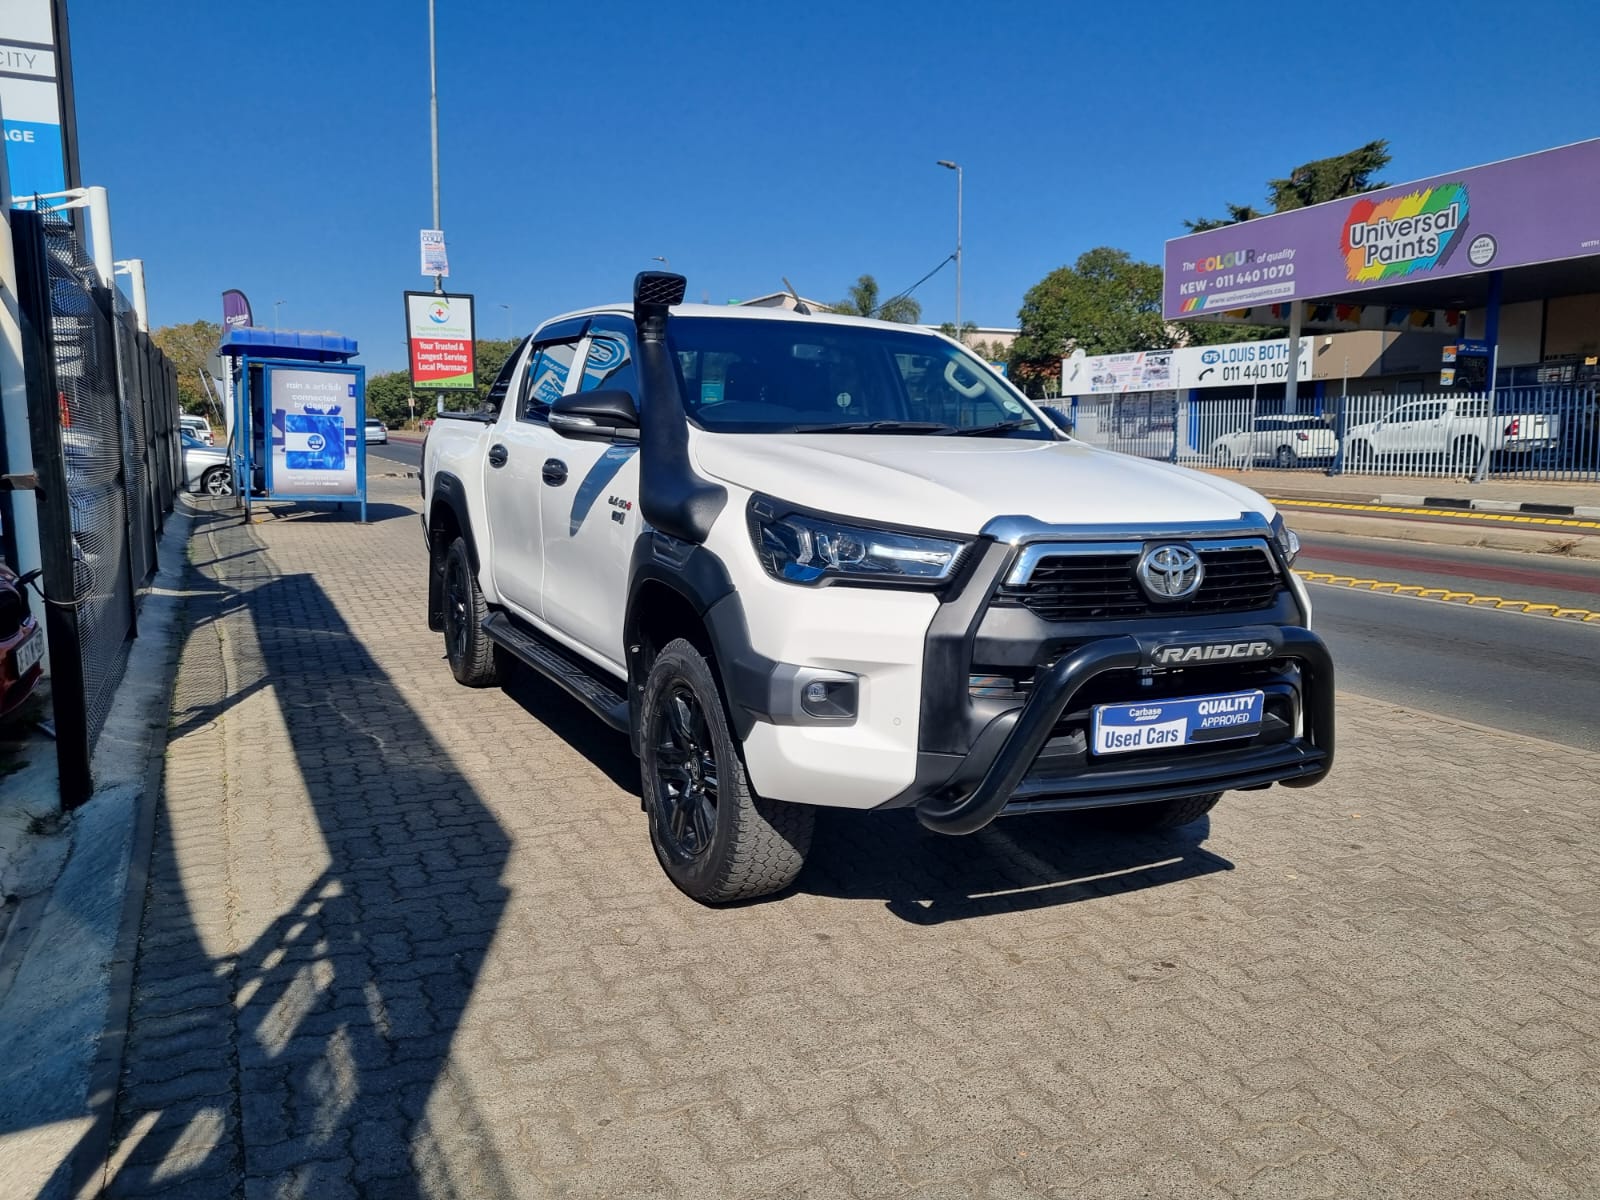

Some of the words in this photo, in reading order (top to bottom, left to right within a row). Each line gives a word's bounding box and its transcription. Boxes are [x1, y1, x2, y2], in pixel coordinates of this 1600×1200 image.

[1351, 205, 1457, 246] Universal
[1366, 235, 1437, 264] Paints
[1182, 262, 1196, 271] The
[1196, 249, 1256, 273] COLOUR
[1257, 252, 1268, 263] of
[1267, 248, 1296, 263] quality
[1180, 280, 1207, 295] KEW
[1216, 274, 1234, 289] 011
[1237, 269, 1260, 285] 440
[1263, 263, 1295, 280] 1070
[1209, 287, 1292, 303] www.universalpaints.co.za
[419, 341, 434, 350] Your
[434, 342, 458, 350] Trusted
[459, 343, 464, 351] &
[1221, 346, 1255, 363] LOUIS
[417, 352, 443, 362] Longest
[444, 352, 468, 363] Serving
[418, 362, 435, 370] Local
[436, 362, 467, 373] Pharmacy
[1223, 366, 1240, 381] 011
[1243, 364, 1267, 379] 440
[291, 394, 336, 402] connected
[294, 401, 304, 410] by
[306, 402, 335, 410] design
[1129, 707, 1162, 717] Carbase
[1198, 696, 1255, 715] QUALITY
[1201, 712, 1249, 728] APPROVED
[1104, 729, 1141, 748] Used
[1146, 727, 1179, 745] Cars
